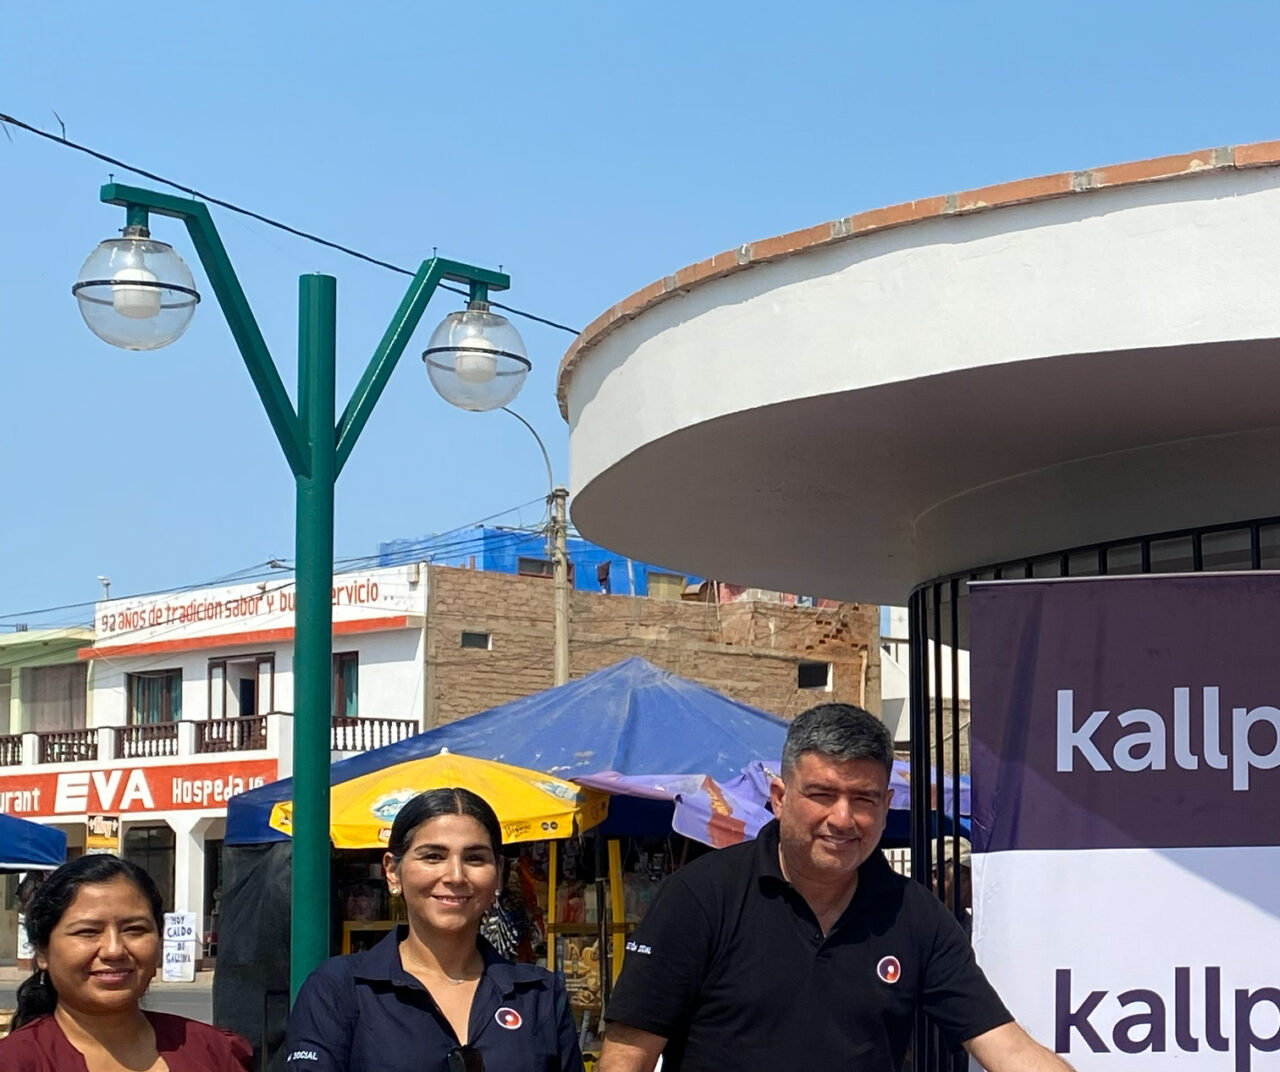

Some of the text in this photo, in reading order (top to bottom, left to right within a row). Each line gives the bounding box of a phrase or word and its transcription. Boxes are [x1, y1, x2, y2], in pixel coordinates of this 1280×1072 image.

[148, 602, 163, 627] de
[224, 595, 263, 618] sabor
[331, 577, 379, 607] ervicio
[54, 769, 155, 813] EVA
